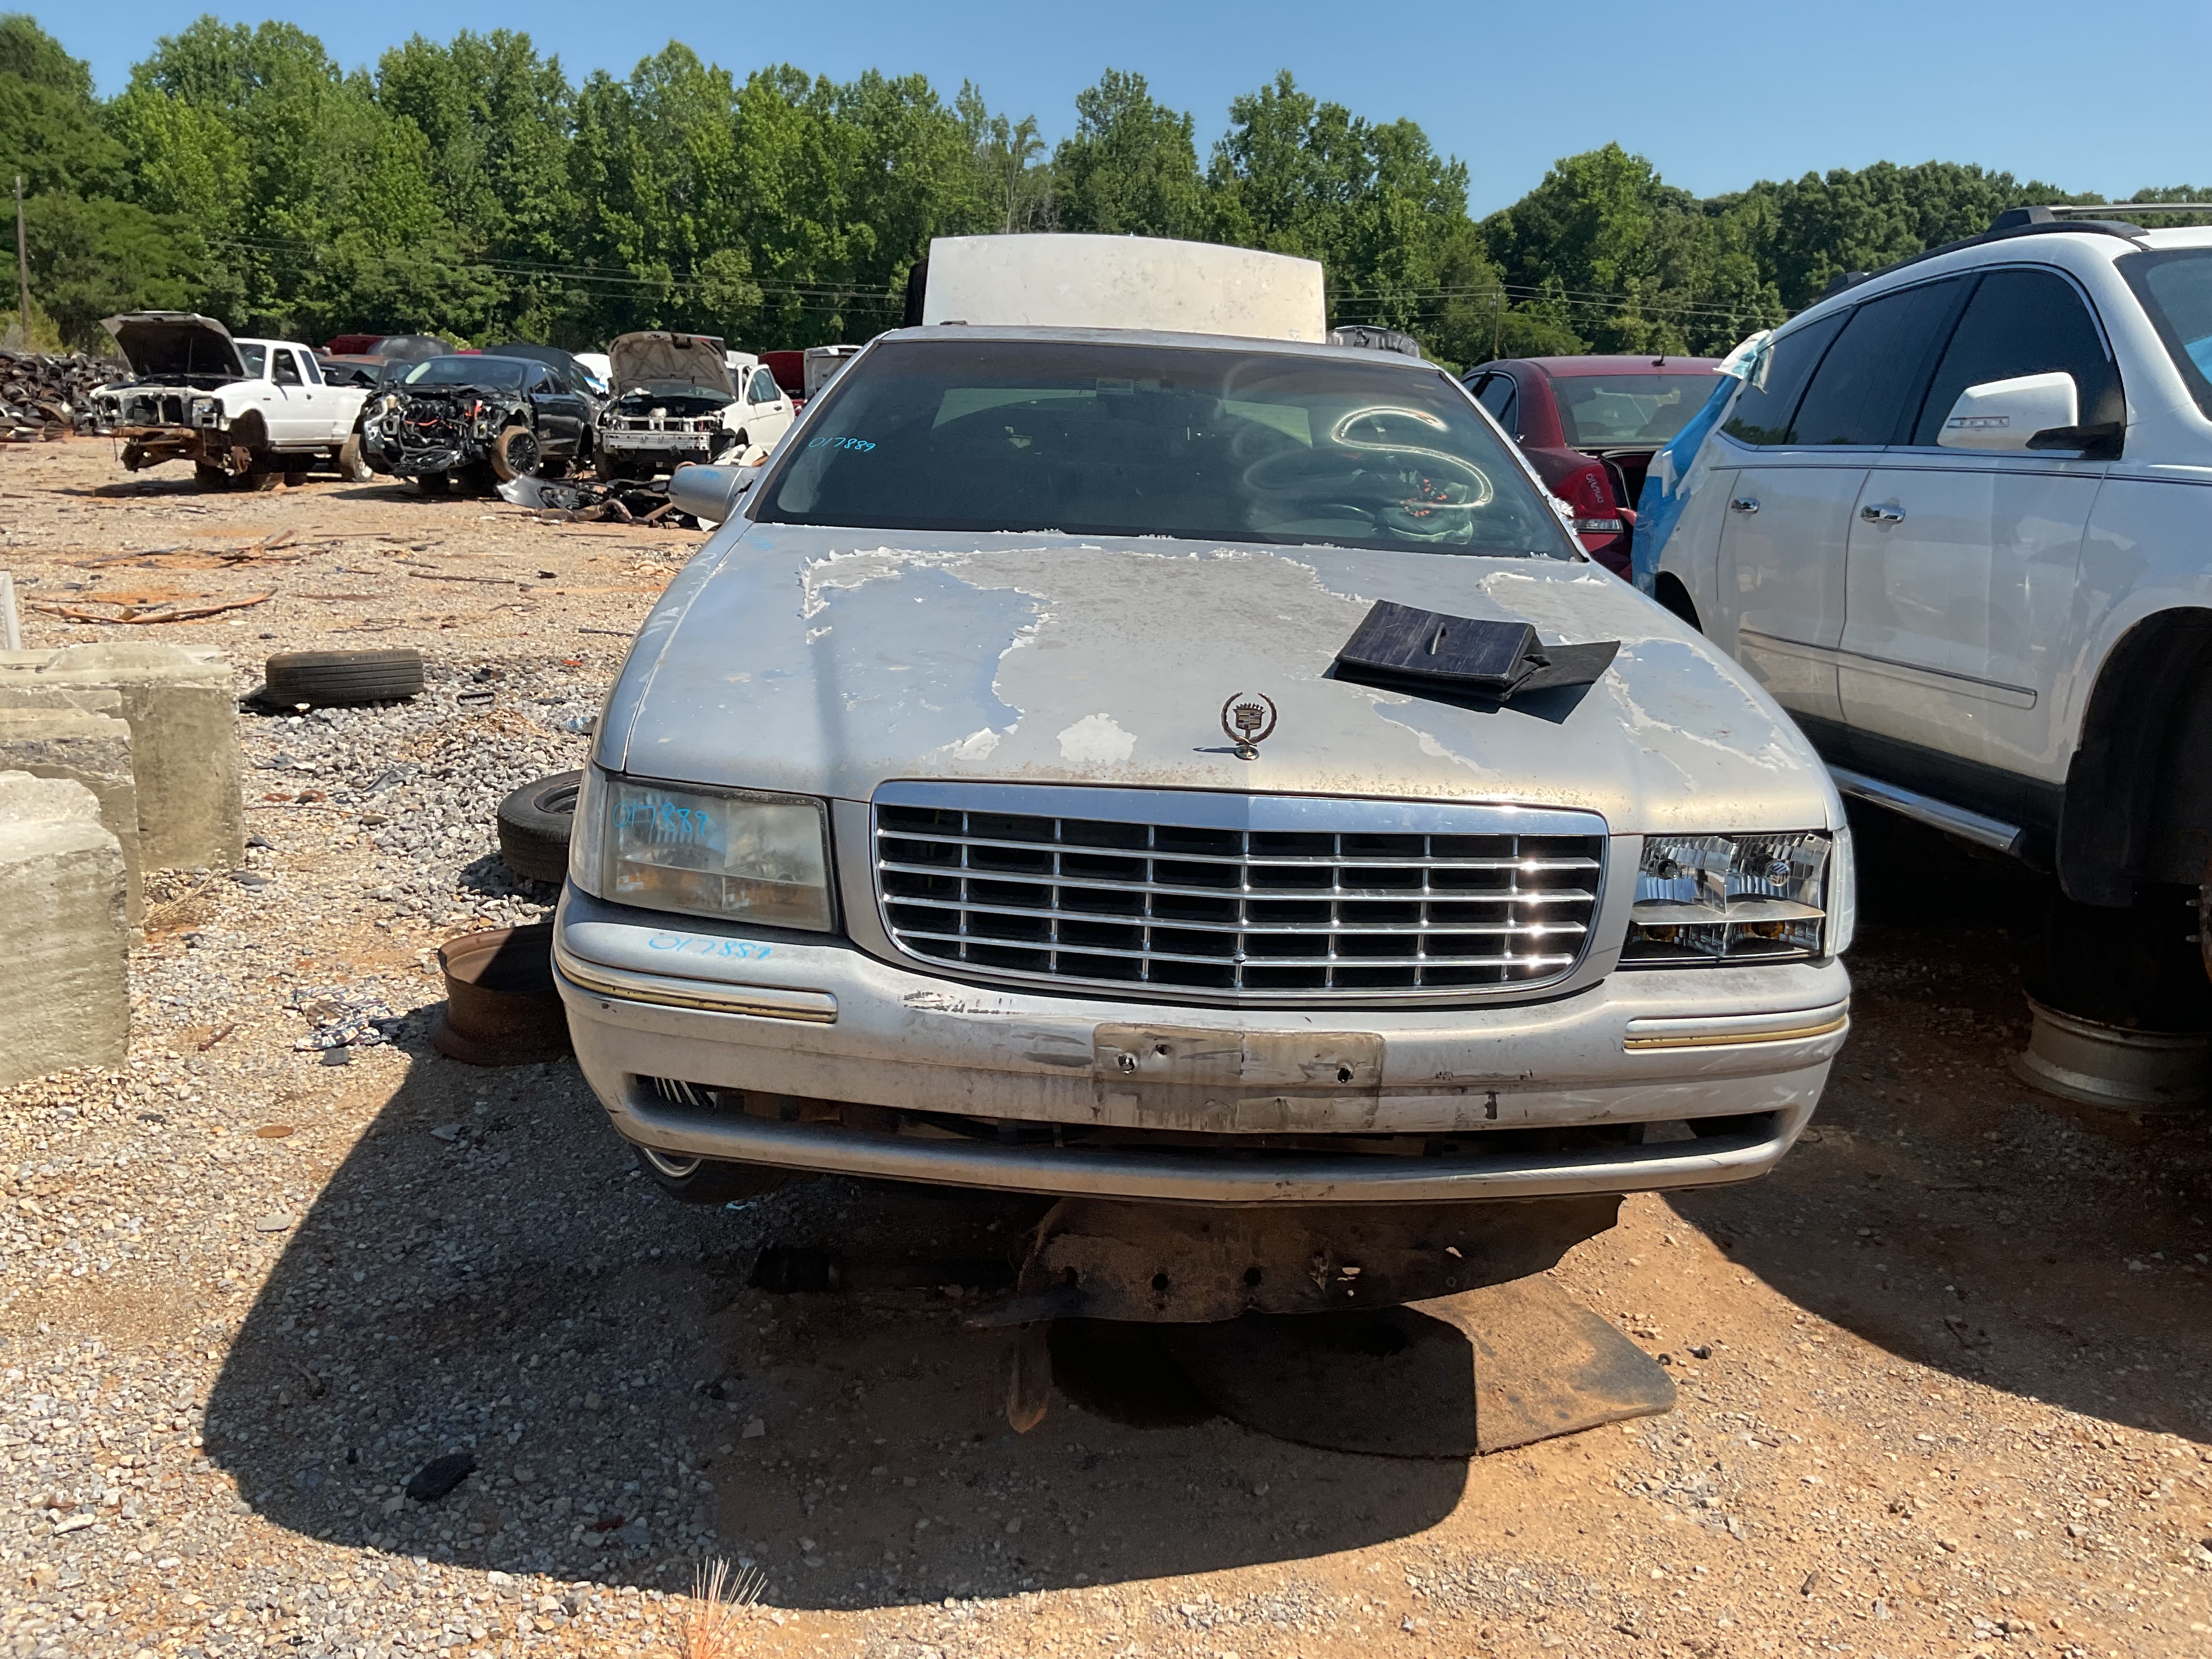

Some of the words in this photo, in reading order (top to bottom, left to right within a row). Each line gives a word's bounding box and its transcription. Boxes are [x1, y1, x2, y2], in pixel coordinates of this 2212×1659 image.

[808, 437, 876, 453] 017889
[612, 801, 707, 836] 017889
[648, 936, 772, 961] 017889
